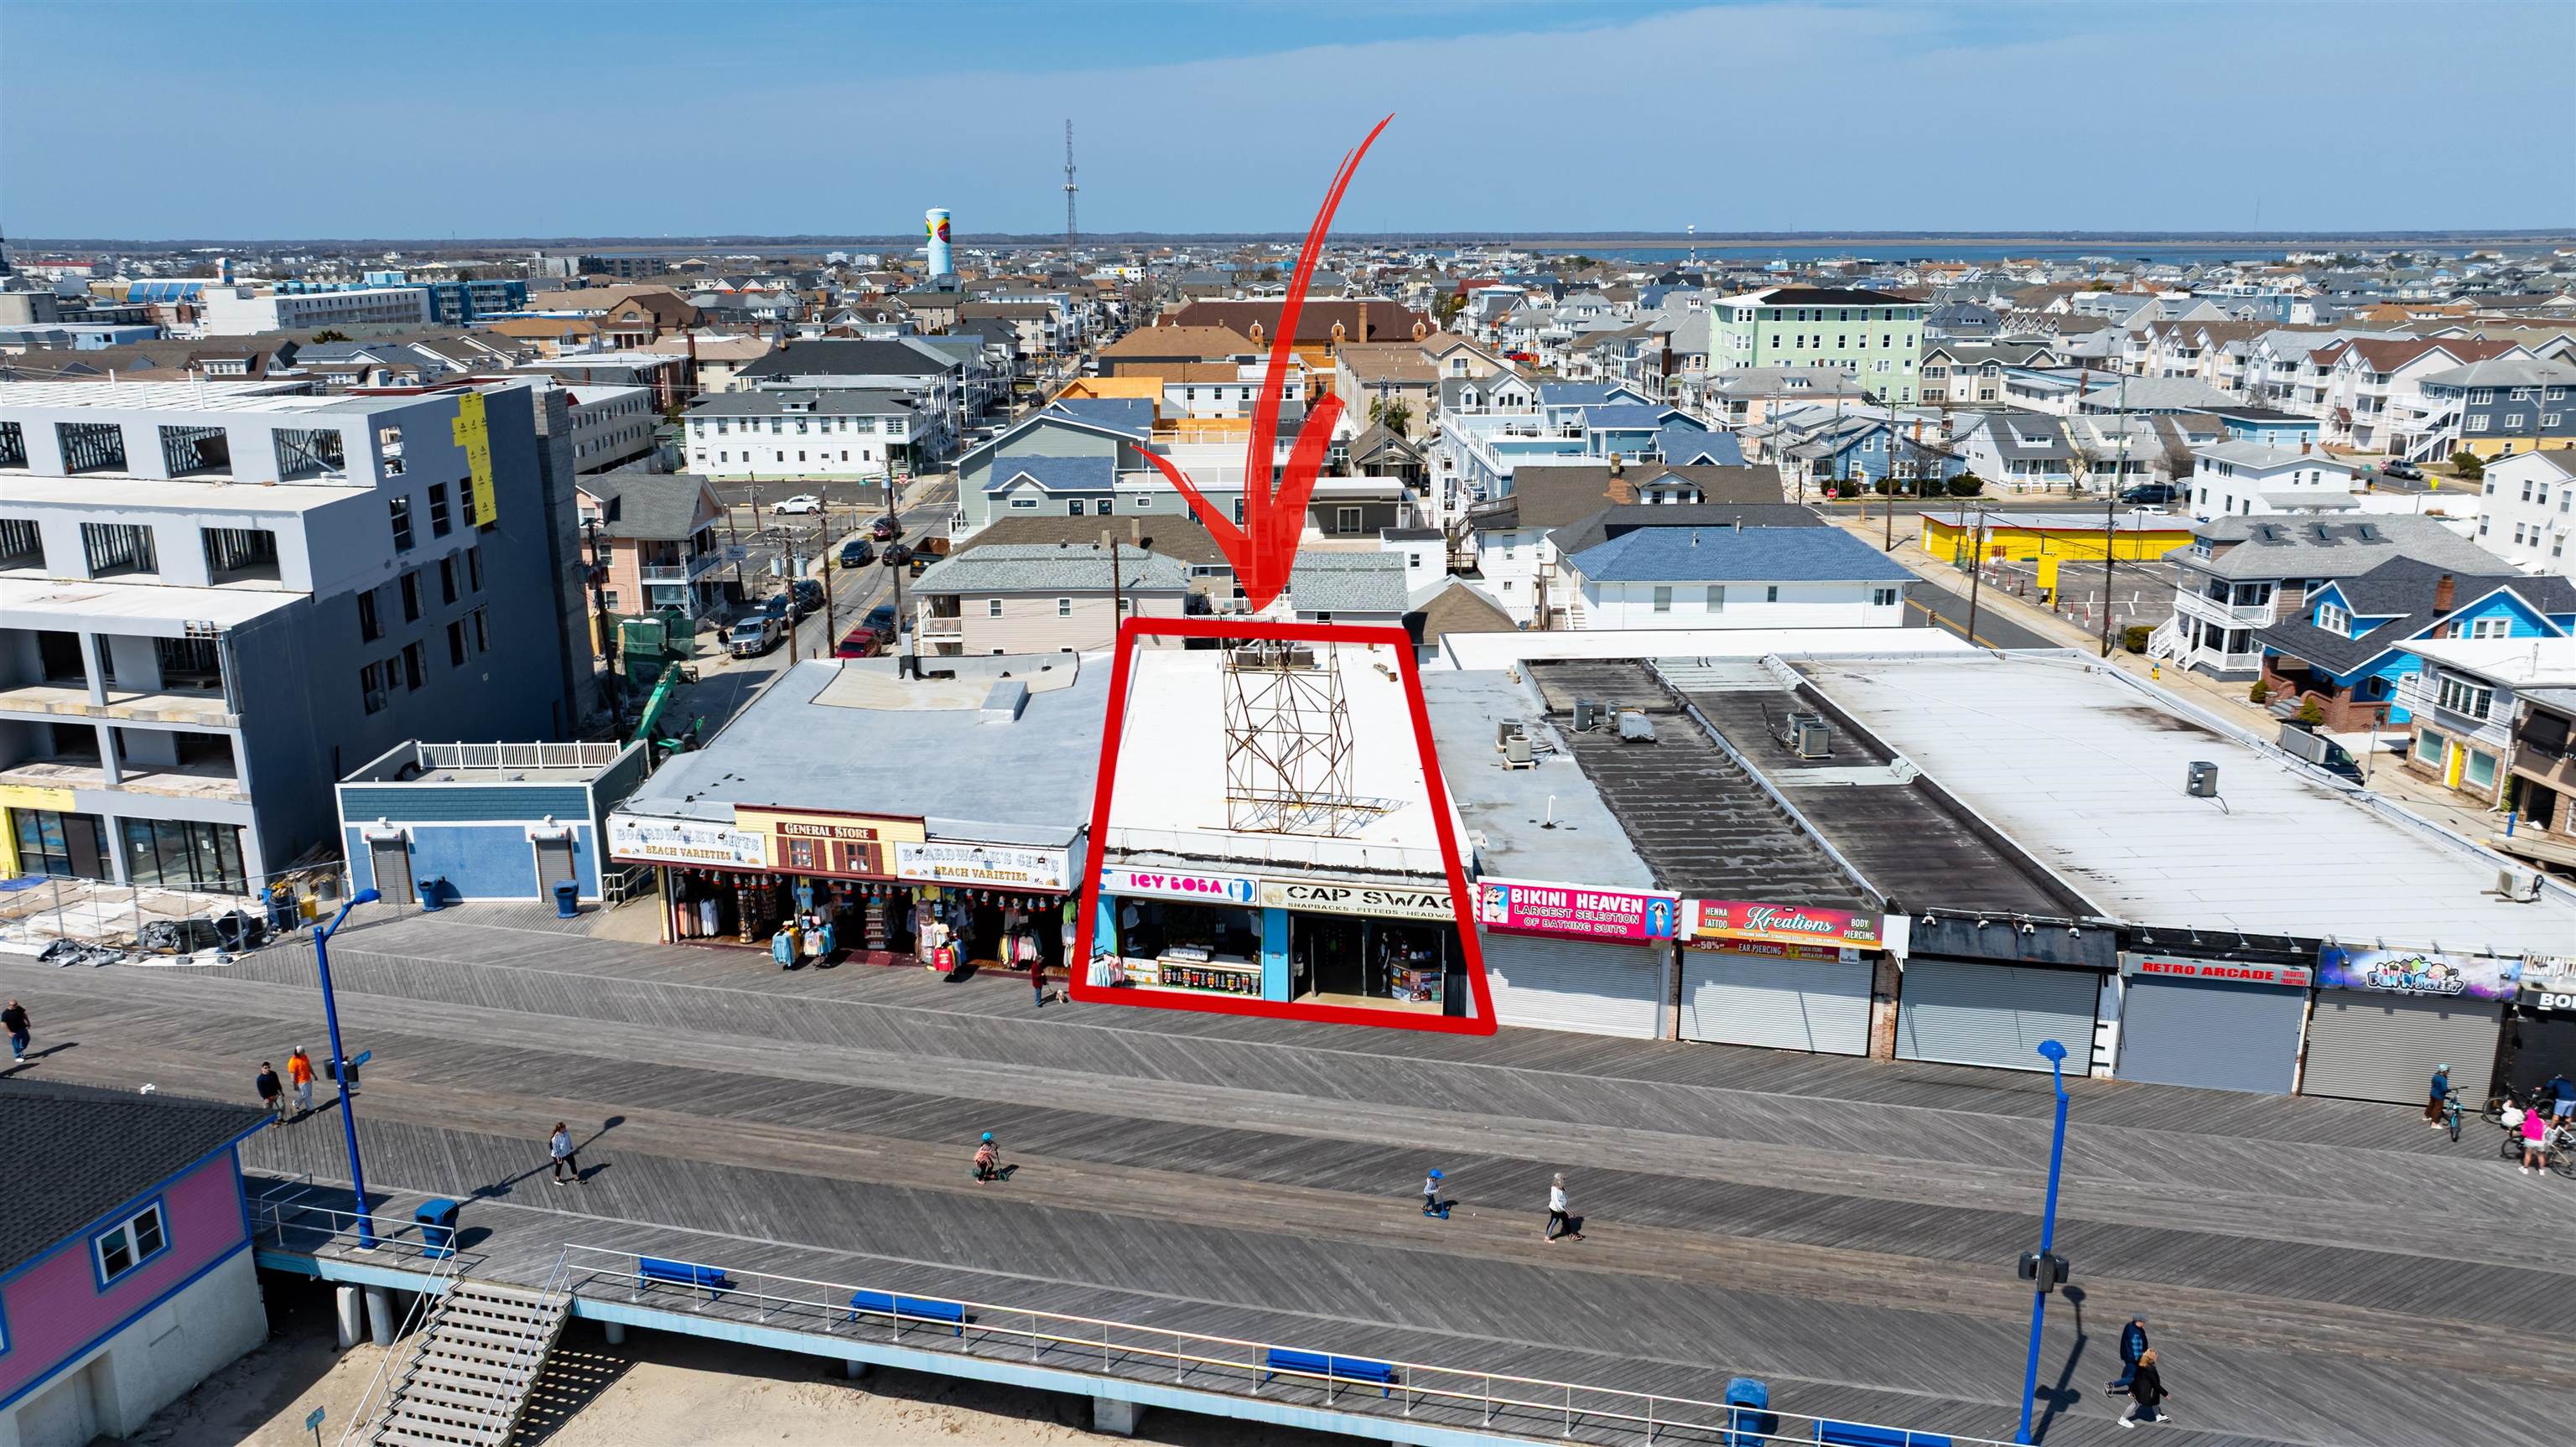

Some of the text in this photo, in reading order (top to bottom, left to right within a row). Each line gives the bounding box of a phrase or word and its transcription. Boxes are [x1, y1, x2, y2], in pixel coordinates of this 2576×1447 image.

[616, 828, 716, 845] BOARDWALK'S
[785, 823, 869, 839] GENERAL STORE
[646, 845, 732, 860] BEACH VARIETIES
[902, 848, 1012, 865] BOARDWALK'S
[934, 866, 1028, 882] BEACH VARIETIES
[1130, 874, 1165, 889] ICY
[1170, 876, 1223, 894] BOBA
[1287, 886, 1352, 902] CAP
[1511, 889, 1644, 914] BIKINI HEAVEN
[1287, 902, 1456, 919] SNAPBACKS FITTEDS HEADWE
[1514, 905, 1639, 924] LARGEST SELECTION
[1705, 907, 1727, 917] HENNA
[1524, 917, 1627, 934] OF BATHING SUITS
[1705, 919, 1727, 929] TATTOO
[1744, 906, 1835, 933] Kreations
[1851, 918, 1869, 928] BODY
[1843, 930, 1875, 941] PIERCING
[1701, 941, 1720, 950] 50%
[1738, 943, 1782, 955] EAR PIERCING
[2142, 962, 2275, 980] RETRO ARCADE
[2369, 972, 2398, 988] FUN
[2415, 972, 2463, 993] SWEET
